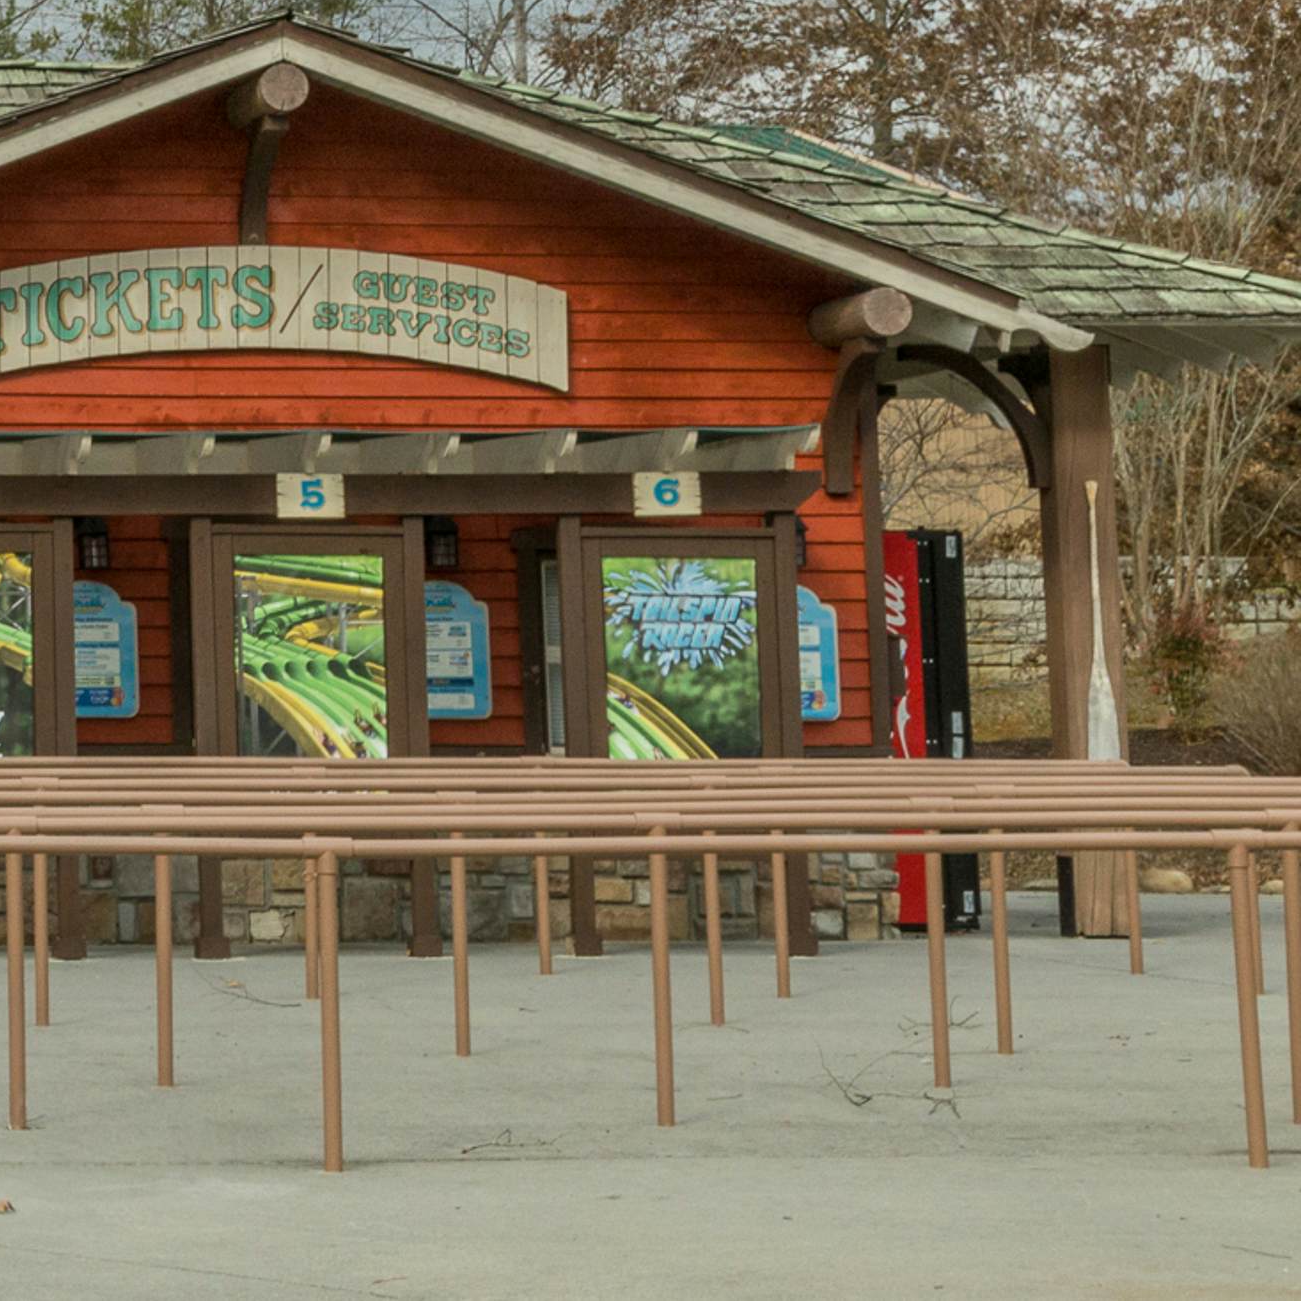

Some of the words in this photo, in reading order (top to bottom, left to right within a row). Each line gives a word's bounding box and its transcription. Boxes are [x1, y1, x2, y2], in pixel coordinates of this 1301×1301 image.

[354, 270, 495, 315] GUEST
[313, 301, 530, 358] SERVICES
[301, 479, 326, 510] 5
[653, 479, 680, 506] 6
